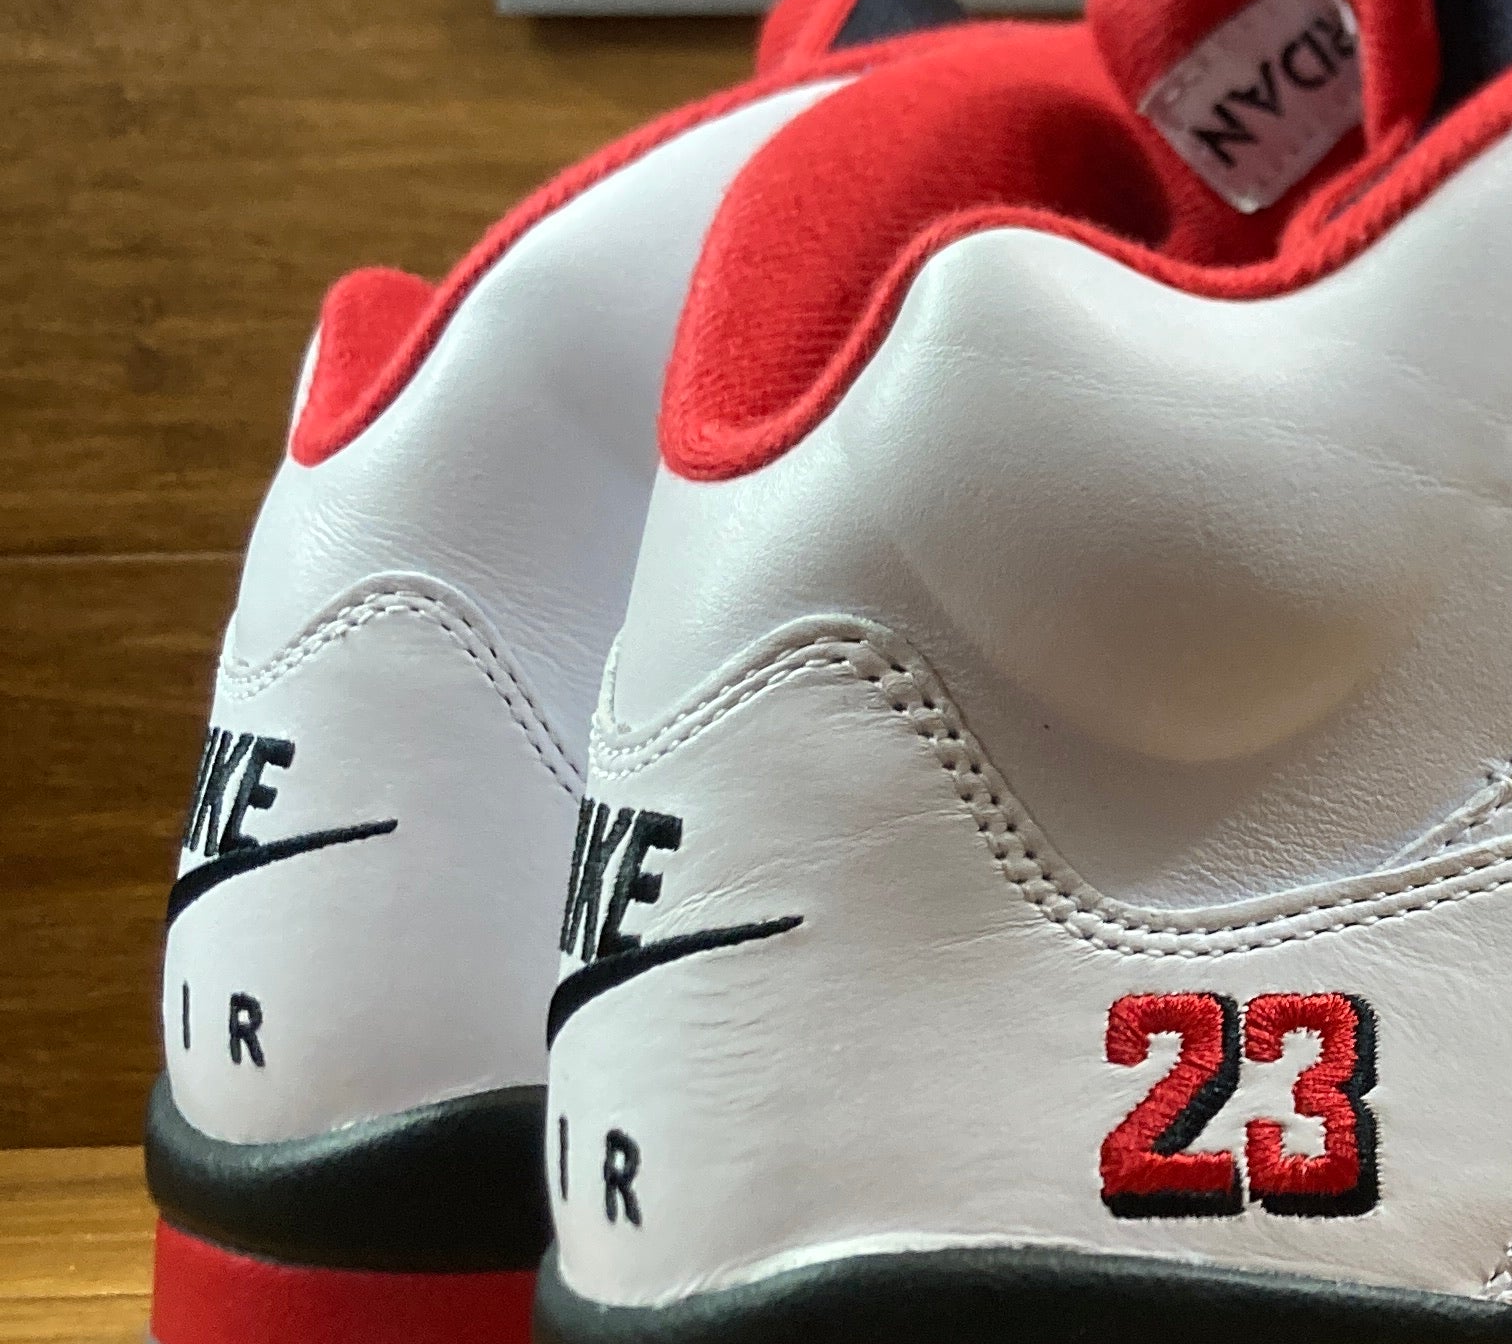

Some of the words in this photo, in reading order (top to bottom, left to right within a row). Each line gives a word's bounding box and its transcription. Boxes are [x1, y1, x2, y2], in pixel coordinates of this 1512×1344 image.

[1189, 17, 1357, 168] RDAN
[181, 724, 296, 857] IKE
[560, 795, 684, 963] IKE
[182, 981, 266, 1067] IR
[559, 1115, 643, 1229] IR
[1099, 992, 1382, 1219] 23
